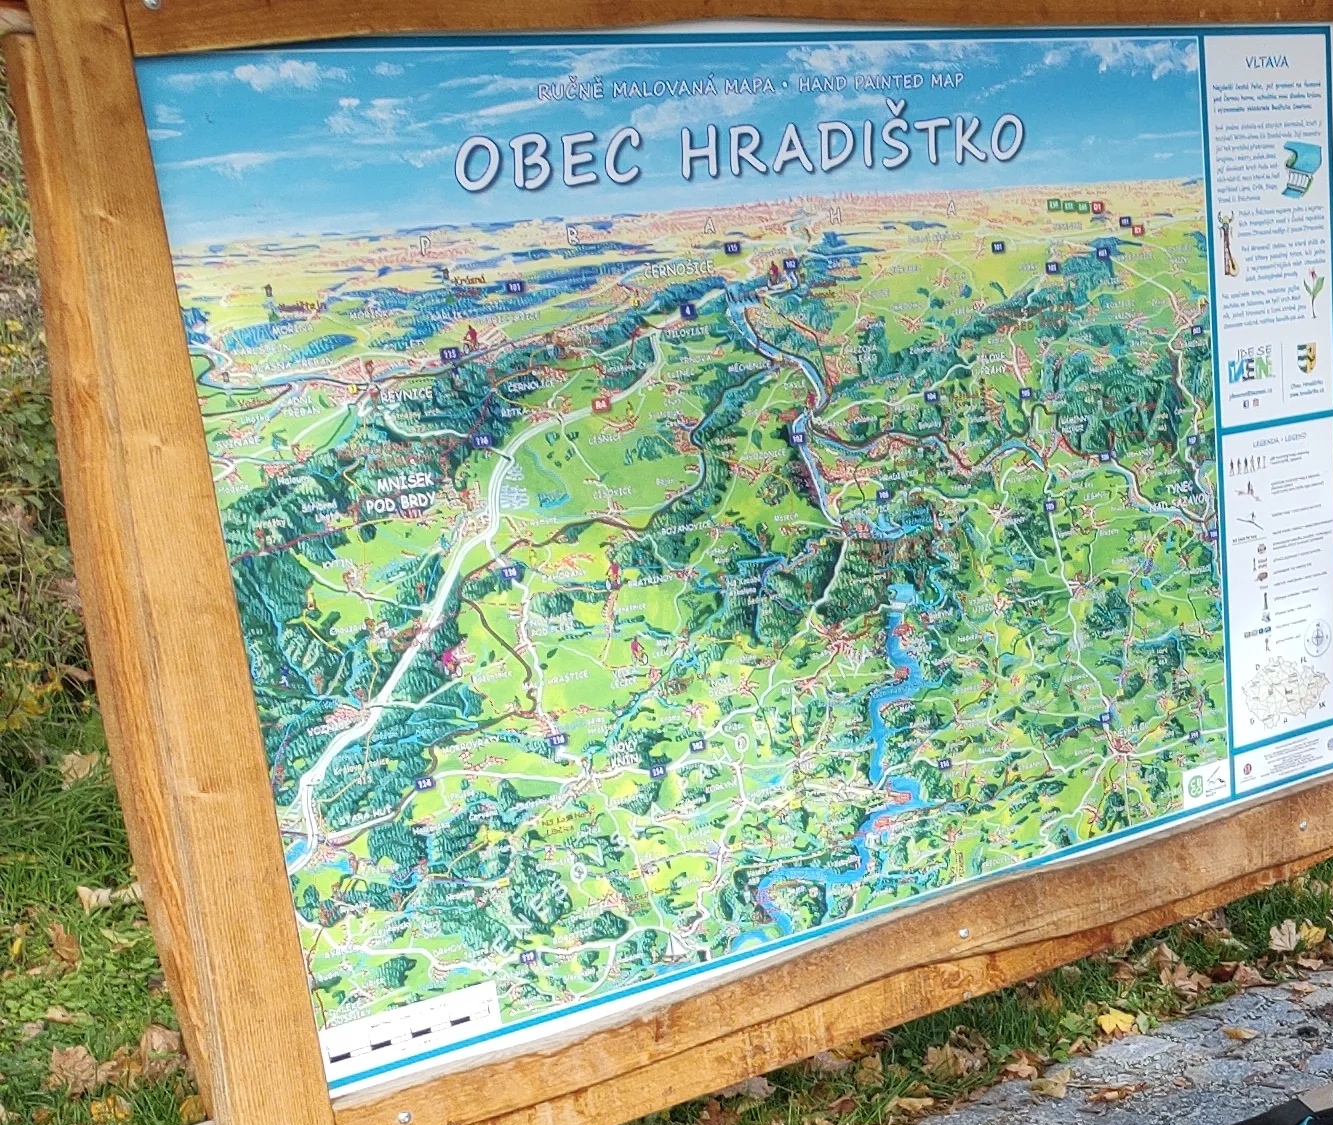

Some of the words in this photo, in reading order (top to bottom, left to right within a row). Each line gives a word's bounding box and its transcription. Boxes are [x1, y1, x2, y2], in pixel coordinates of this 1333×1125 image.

[1245, 54, 1290, 69] VLTAVA
[537, 80, 605, 102] RUČNĚ
[612, 75, 719, 100] MALOVANÁ
[725, 76, 775, 96] MAPA
[798, 74, 848, 92] HAND
[854, 72, 925, 91] PAINTED
[930, 71, 965, 89] MAP
[453, 125, 644, 195] OBEC
[679, 97, 1027, 182] HRADIŠTKO
[643, 259, 715, 279] ČERNOŠICE
[366, 498, 397, 514] POD
[400, 491, 437, 510] BRDY
